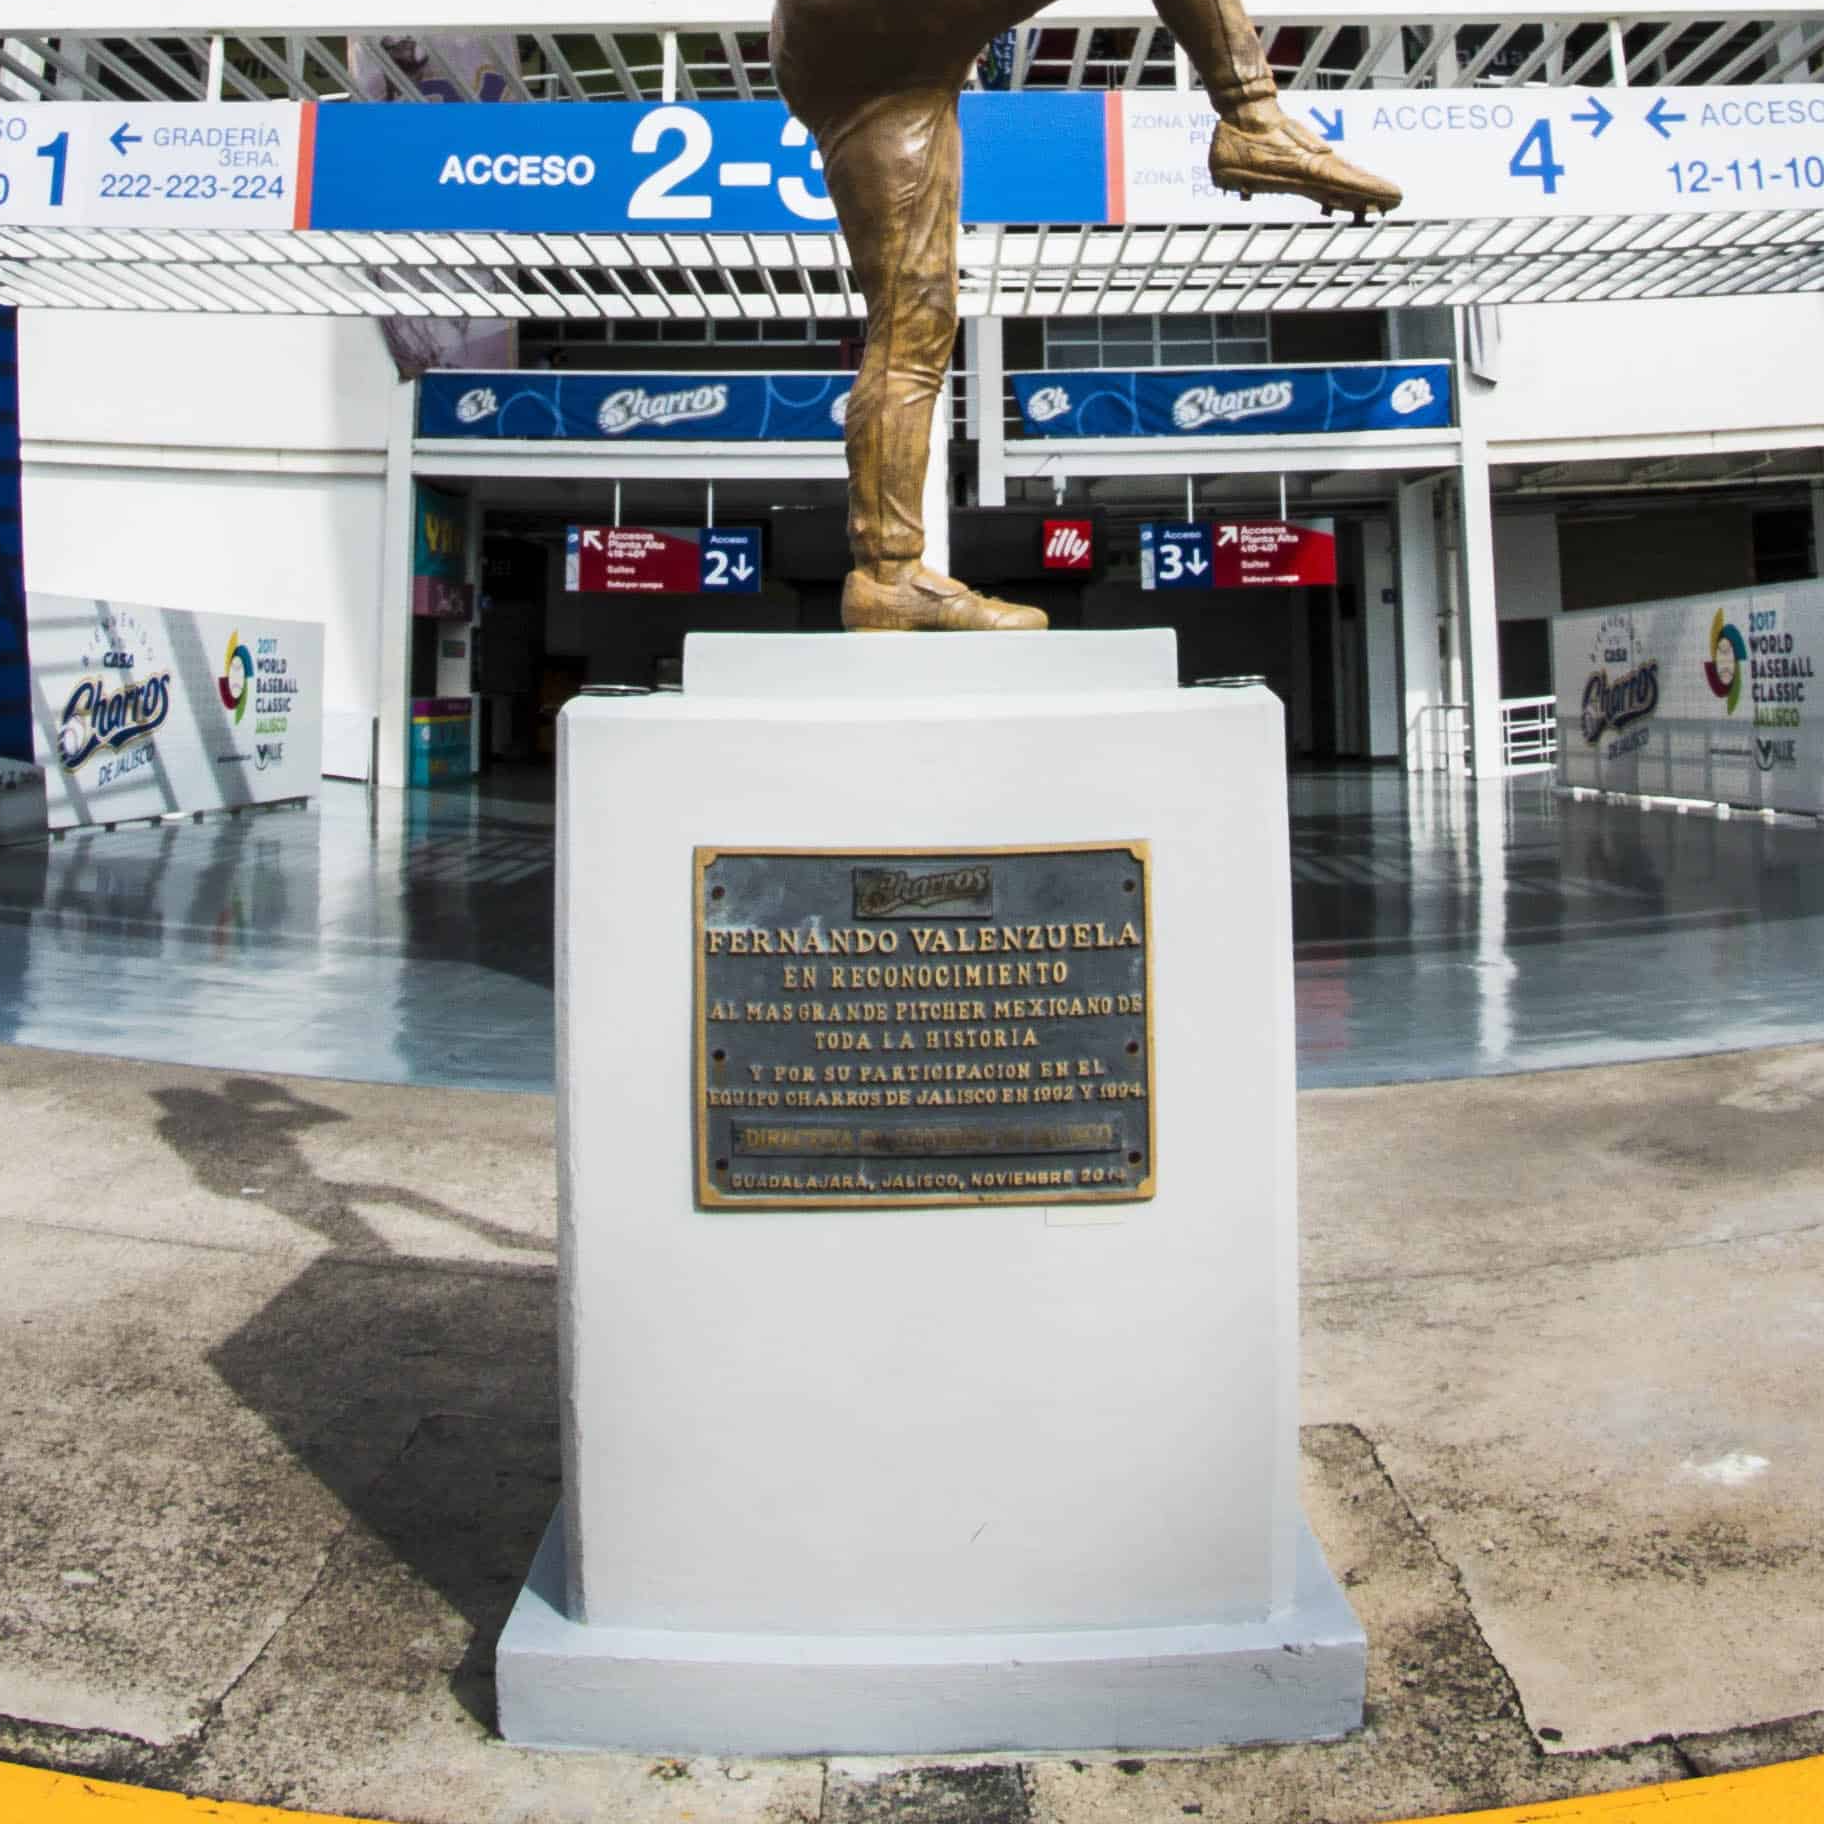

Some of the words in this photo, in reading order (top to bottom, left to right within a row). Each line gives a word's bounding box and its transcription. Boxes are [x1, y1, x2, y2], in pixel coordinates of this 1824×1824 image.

[153, 127, 282, 147] GRADERÍA
[1373, 105, 1514, 132] ACCESO
[1508, 118, 1564, 194] 4
[36, 131, 70, 206] 1
[218, 148, 280, 167] 3ERA.
[439, 154, 595, 187] ACCESO
[100, 174, 285, 200] 222-223-224
[598, 383, 728, 434] Charros
[1172, 380, 1293, 429] Charros
[709, 534, 749, 545] Acceso
[1046, 527, 1089, 564] illy
[1163, 529, 1202, 540] Acceso
[704, 550, 729, 585] 2
[1159, 544, 1184, 581] 3
[1749, 610, 1776, 632] 2017
[1749, 633, 1793, 655] WORLD
[256, 658, 288, 674] WORLD
[1751, 656, 1814, 679] BASEBALL
[256, 677, 298, 694] BASEBALL
[1752, 682, 1805, 703] CLASSIC
[256, 697, 292, 713] CLASSIC
[59, 673, 171, 770] Charros
[708, 929, 898, 954] FERNANDO
[909, 922, 1141, 953] VALENZUELA
[783, 965, 816, 989] EN
[831, 961, 1069, 989] RECONOCIMIENTO
[710, 1001, 738, 1022] AL
[746, 1003, 794, 1023] MAS
[798, 1001, 888, 1023] GRANDE
[895, 1000, 987, 1022] PITCHER
[992, 996, 1112, 1020] MEXICANO
[1117, 994, 1143, 1014] DE
[815, 1031, 872, 1051] TODA
[881, 1031, 915, 1050] LA
[925, 1027, 1041, 1049] HISTORIA
[750, 1064, 763, 1083] Y
[775, 1064, 816, 1084] POR
[824, 1064, 850, 1083] SU
[859, 1062, 1032, 1084] PARTICIPACION
[1039, 1061, 1070, 1080] EN
[1077, 1059, 1106, 1078] EL
[709, 1087, 778, 1108] EQUIPO
[784, 1088, 881, 1108] CHARROS
[885, 1088, 911, 1107] DE
[915, 1086, 998, 1107] JALISCO
[1001, 1085, 1029, 1105] EN
[1032, 1084, 1074, 1104] 1992
[1079, 1083, 1095, 1102] Y
[731, 1172, 875, 1193] GUADALAJARA,
[881, 1172, 966, 1193] JALISCO,
[971, 1169, 1074, 1188] NOVIEMBRE
